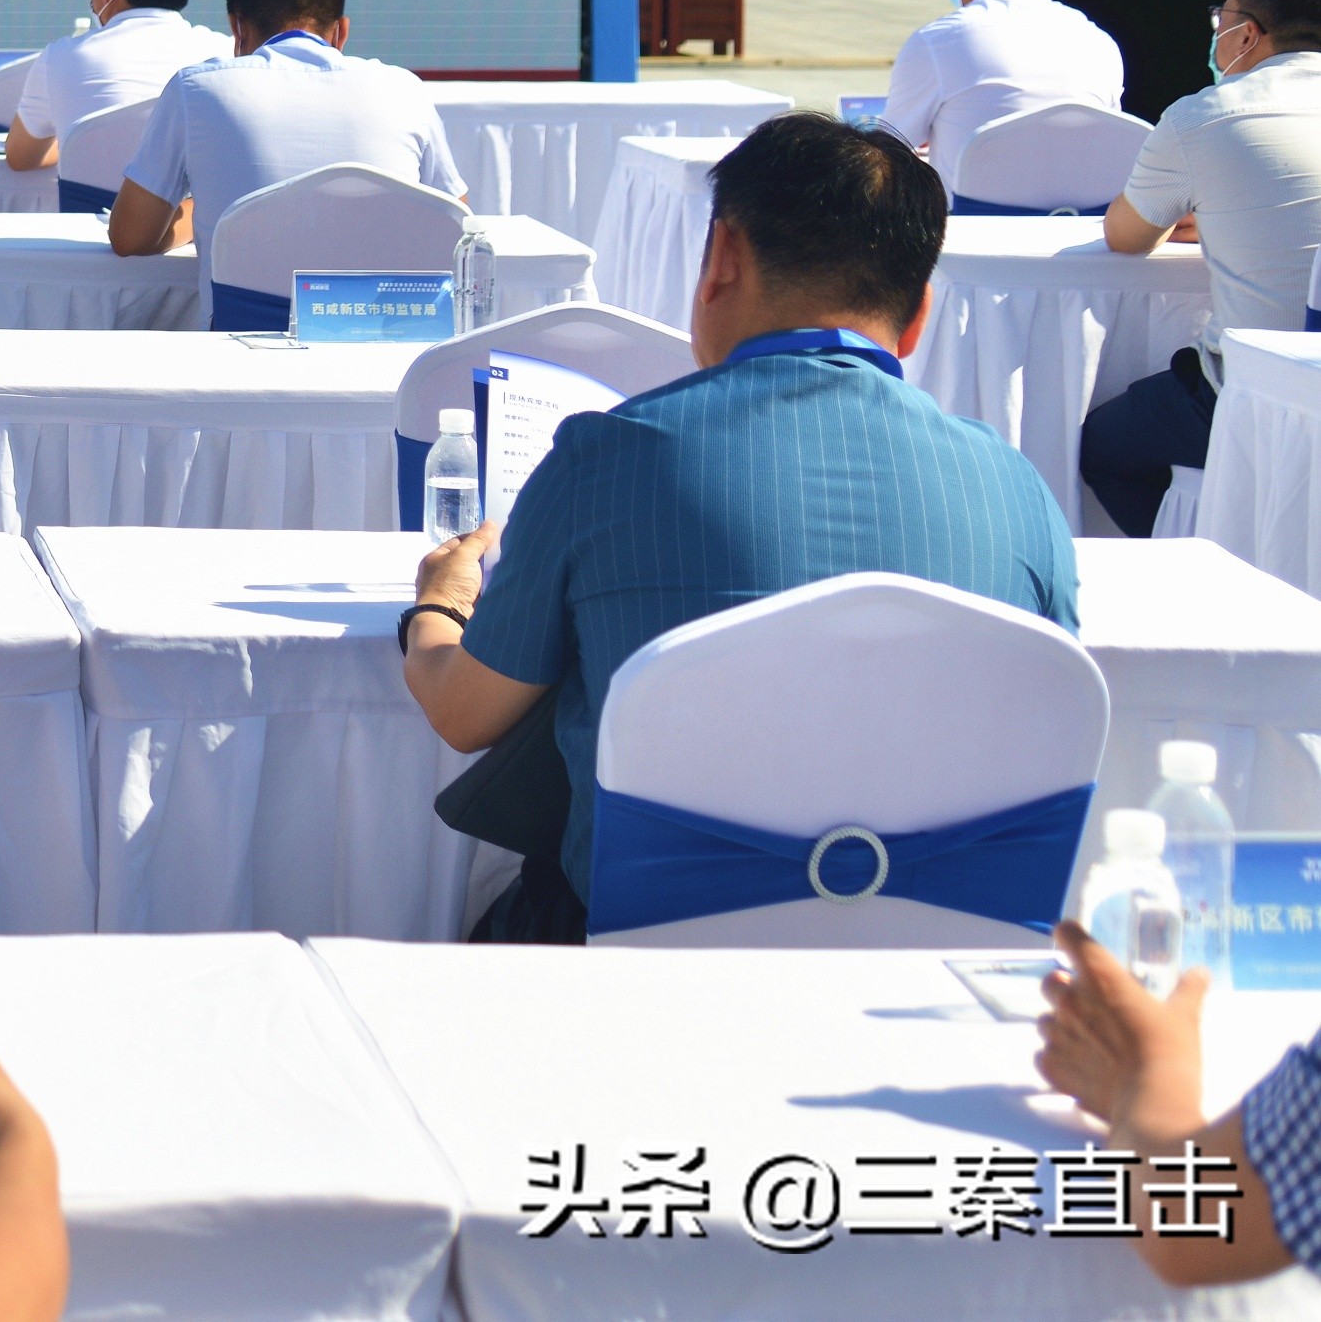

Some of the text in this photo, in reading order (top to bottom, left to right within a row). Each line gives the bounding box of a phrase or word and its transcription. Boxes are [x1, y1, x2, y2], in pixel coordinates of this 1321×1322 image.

[311, 302, 438, 317] 西咸新区市场监管局
[491, 369, 504, 378] 02
